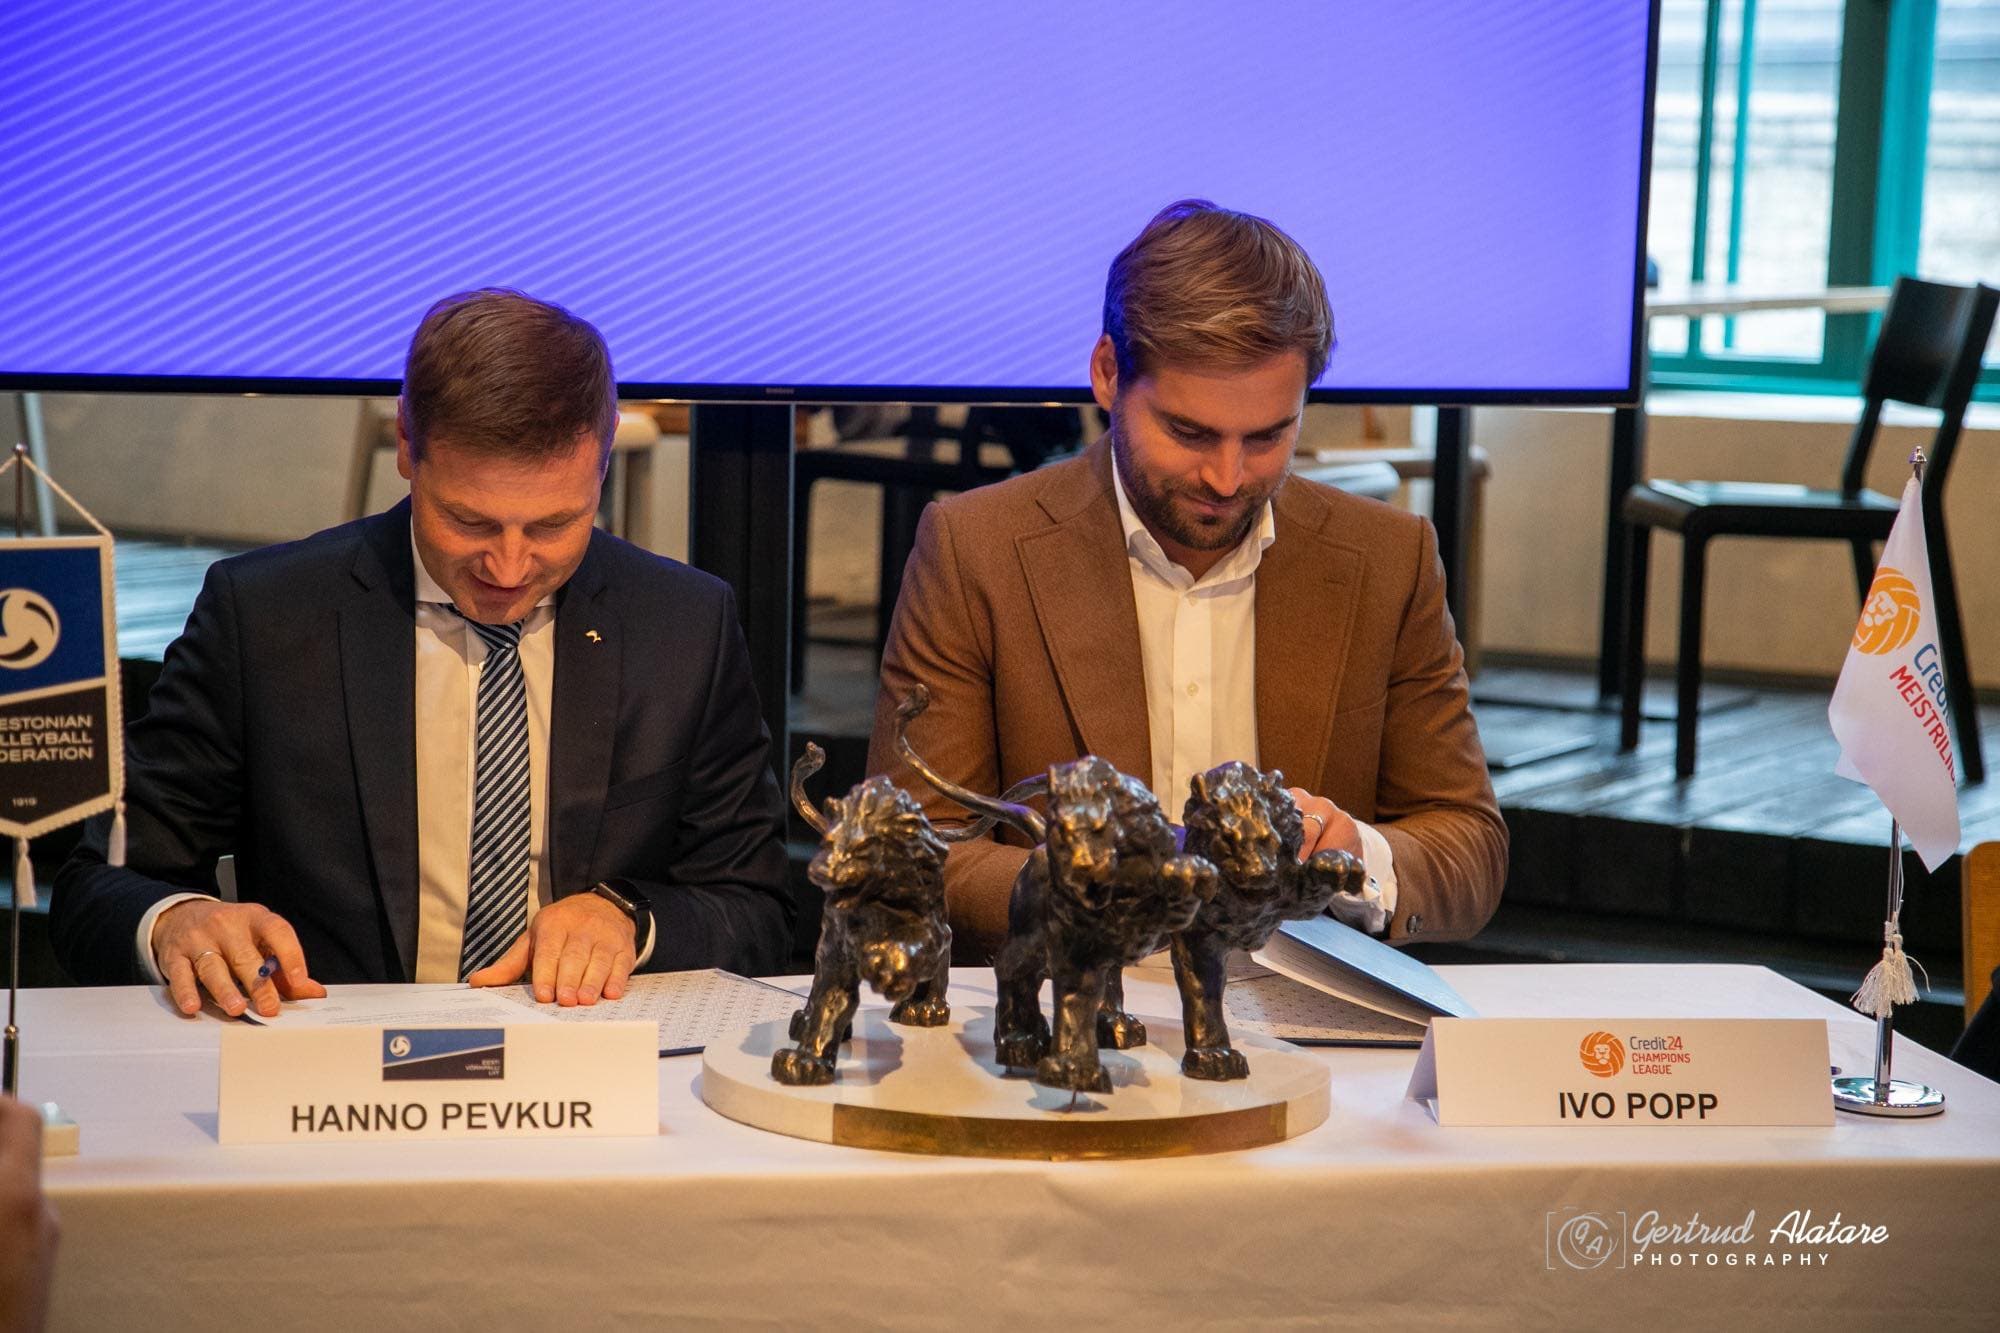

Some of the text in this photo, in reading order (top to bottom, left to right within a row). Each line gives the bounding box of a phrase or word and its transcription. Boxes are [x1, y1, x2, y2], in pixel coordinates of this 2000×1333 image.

[0, 714, 93, 731] ESTONIAN
[1889, 664, 1956, 788] MEISTRILII
[0, 731, 93, 747] LLEYBALL
[0, 746, 94, 763] DERATION
[1629, 1036, 1683, 1050] Credit24
[1631, 1052, 1691, 1063] CHAMPIONS
[1632, 1064, 1672, 1075] LEAGUE
[1559, 1092, 1719, 1120] IVO POPP
[292, 1101, 594, 1133] HANNO PEVKUR
